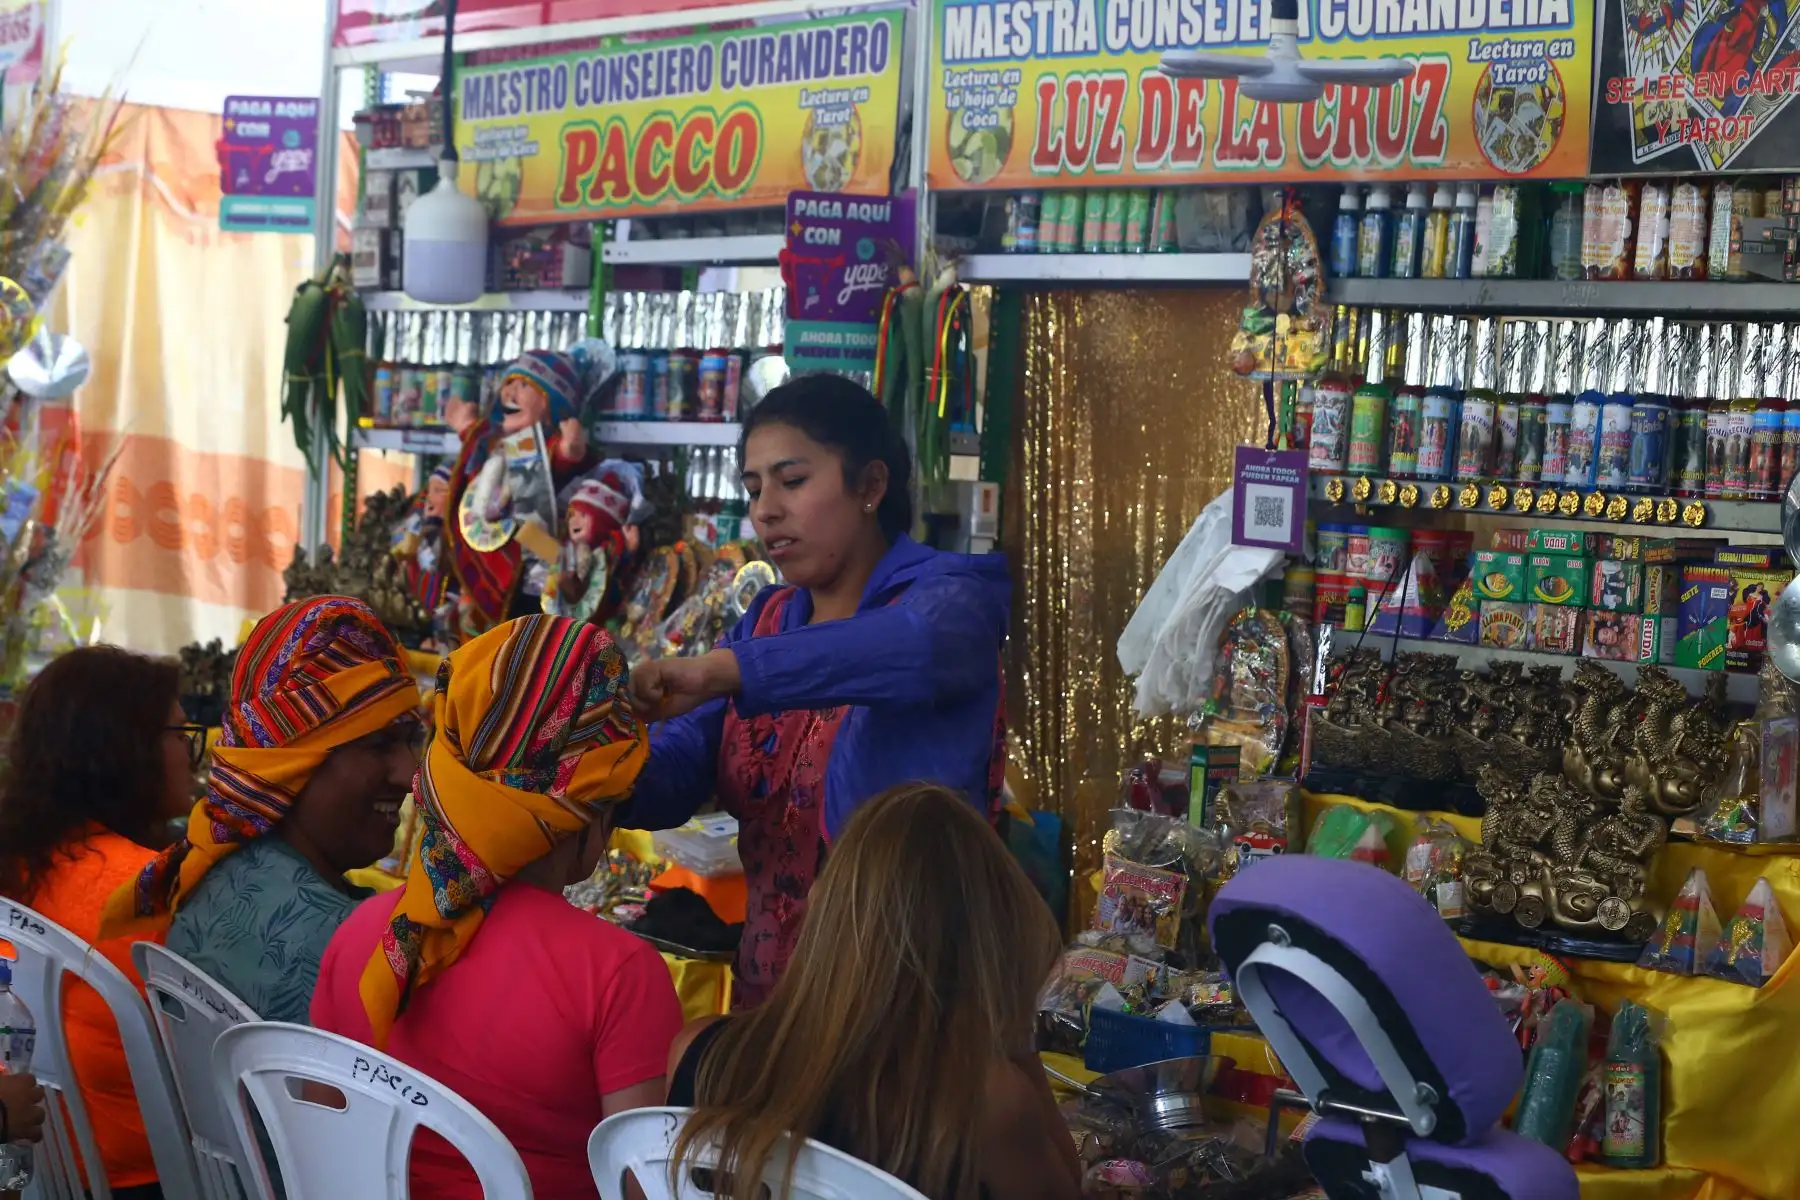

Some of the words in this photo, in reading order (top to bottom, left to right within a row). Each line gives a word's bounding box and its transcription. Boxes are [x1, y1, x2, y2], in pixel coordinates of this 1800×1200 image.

[944, 0, 1096, 60] MAESTRA
[1468, 39, 1544, 60] Lectura
[1549, 40, 1573, 57] en
[463, 65, 567, 120] MAESTRO
[576, 44, 712, 107] CONSEJERO
[721, 21, 889, 86] CURANDERO
[943, 69, 999, 88] Lectura
[1003, 70, 1020, 85] en
[1493, 62, 1546, 84] Tarot
[1605, 76, 1636, 104] SE
[1643, 74, 1686, 100] LEE
[1693, 70, 1726, 97] EN
[1731, 67, 1800, 97] CART
[946, 91, 960, 108] la
[964, 90, 995, 109] hoja
[999, 88, 1016, 105] de
[816, 107, 850, 124] Tarot
[963, 110, 998, 128] Coca
[1034, 76, 1126, 168] LUZ
[1137, 74, 1203, 167] DE
[1214, 78, 1284, 164] LA
[1301, 62, 1448, 162] CRUZ
[1655, 118, 1672, 144] Y
[1677, 115, 1755, 144] TAROT
[559, 111, 758, 203] PACCO
[794, 199, 844, 218] PAGA
[846, 201, 892, 222] AQUÍ
[804, 226, 842, 246] CON
[837, 263, 889, 306] yape
[800, 331, 843, 344] AHORA
[845, 332, 878, 346] TODO
[1241, 471, 1270, 480] PUEDEN
[1272, 474, 1300, 483] YAPEAR
[1245, 464, 1271, 473] AHORA
[1272, 466, 1297, 476] TODOS
[1544, 536, 1567, 550] RUDA
[1680, 584, 1699, 603] SIETE
[1641, 618, 1655, 660] RUDA
[1698, 644, 1724, 669] PODERES
